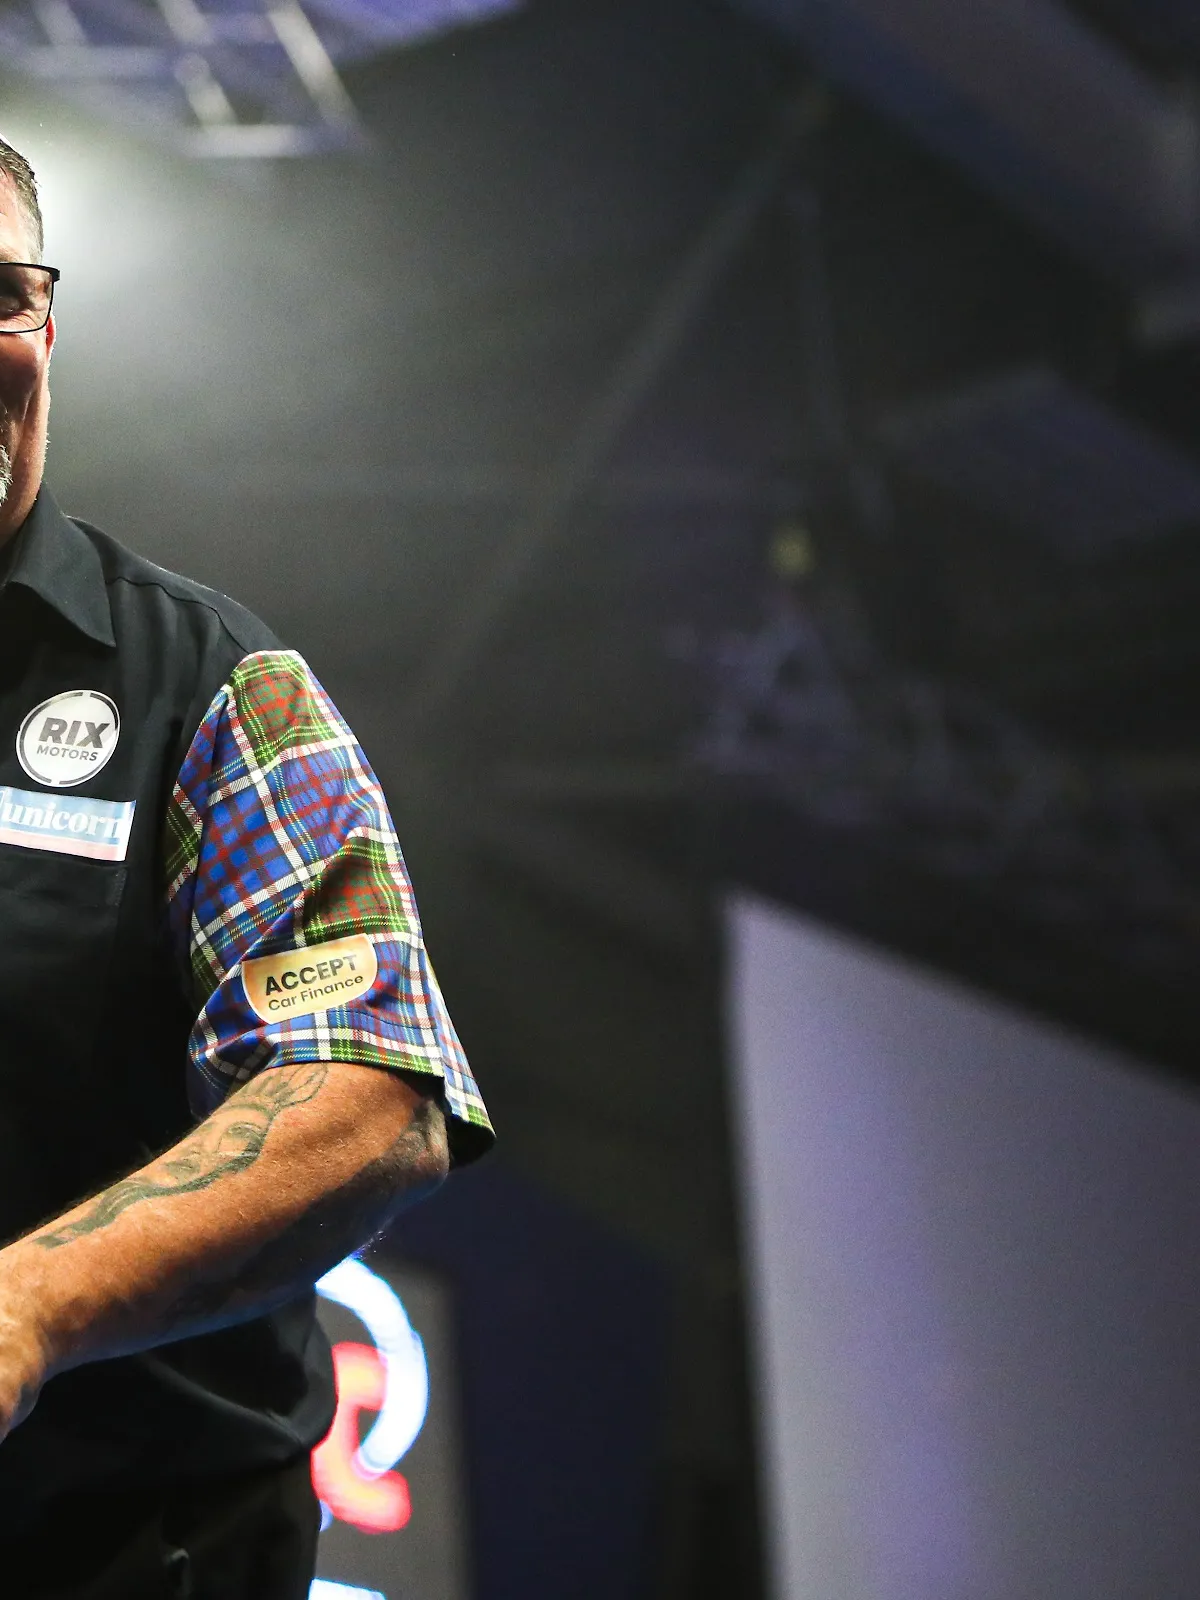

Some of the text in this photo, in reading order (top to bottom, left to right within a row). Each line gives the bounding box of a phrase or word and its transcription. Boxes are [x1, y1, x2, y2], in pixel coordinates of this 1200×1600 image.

[38, 717, 111, 749] RIX
[36, 745, 98, 762] MOTORS
[2, 802, 124, 839] unicorn
[265, 954, 357, 996] ACCEPT
[268, 975, 364, 1011] Car Finance
